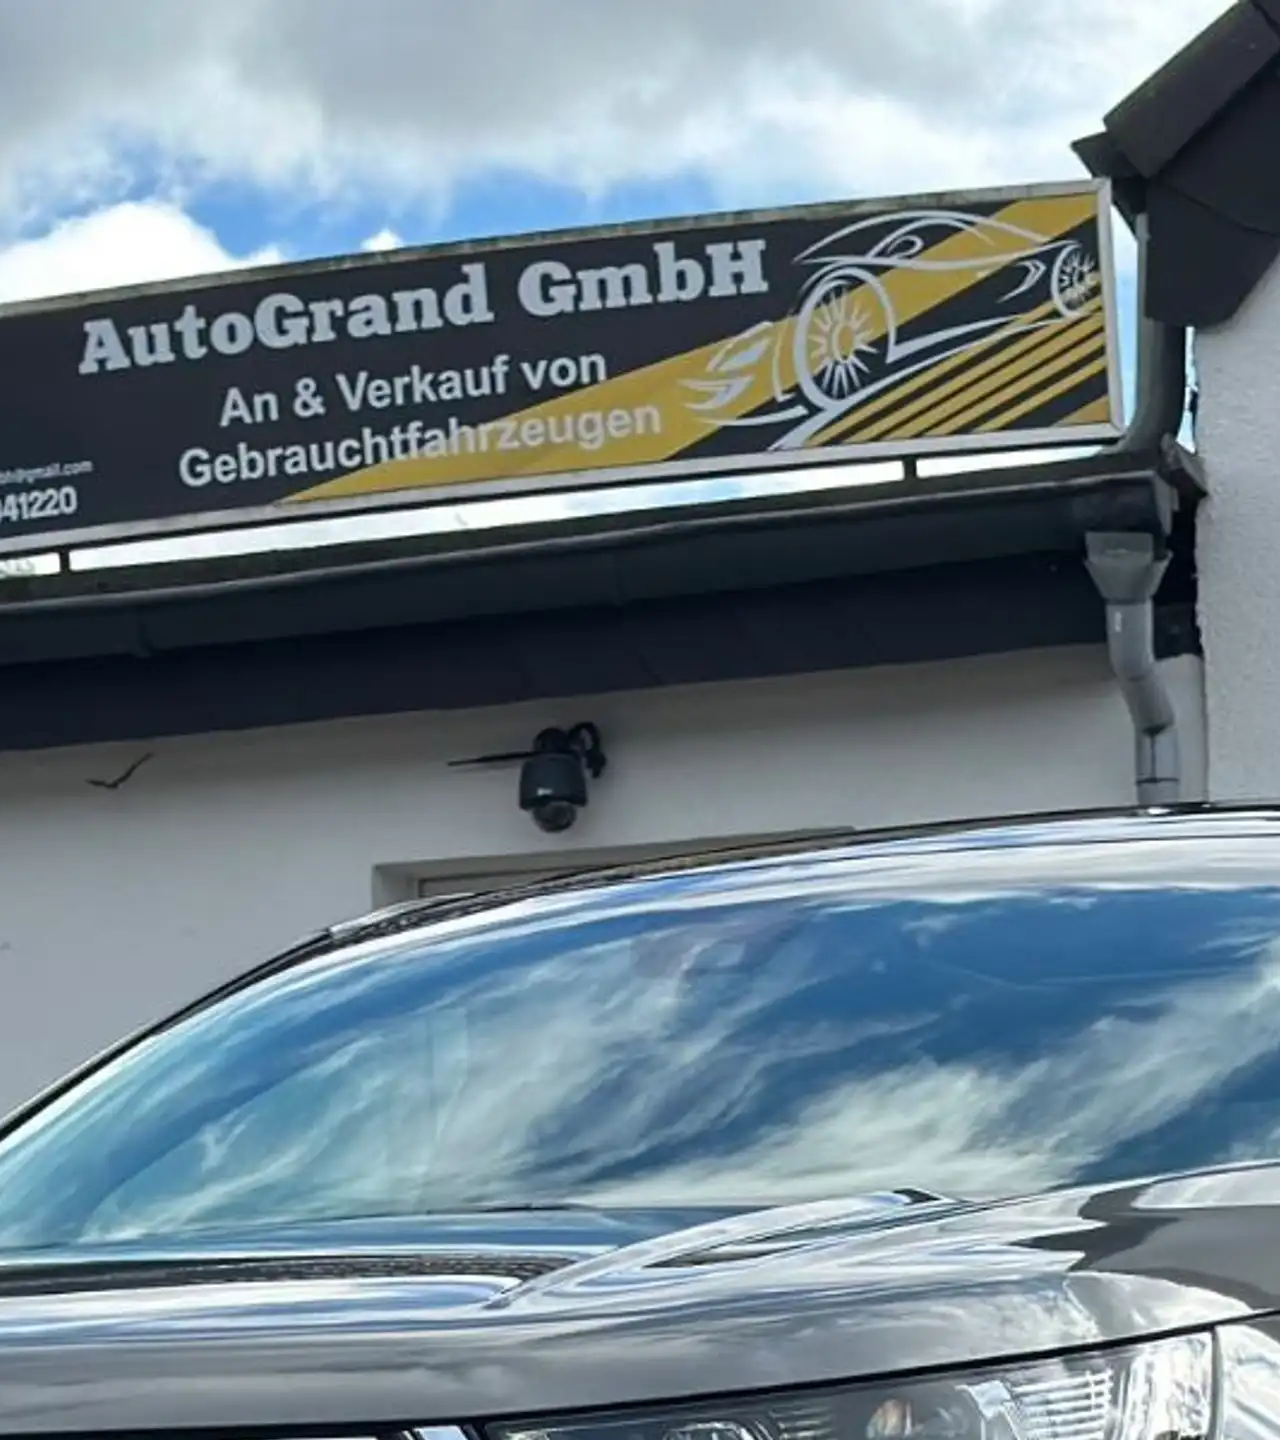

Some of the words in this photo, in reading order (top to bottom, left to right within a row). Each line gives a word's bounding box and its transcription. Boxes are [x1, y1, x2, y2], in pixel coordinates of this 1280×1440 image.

[78, 262, 495, 375] AutoGrand
[517, 239, 769, 318] GmbH
[219, 387, 280, 427] An
[292, 377, 326, 418] &
[336, 354, 511, 412] Verkauf
[520, 352, 608, 391] von
[178, 403, 662, 488] Gebrauchtfahrzeugen
